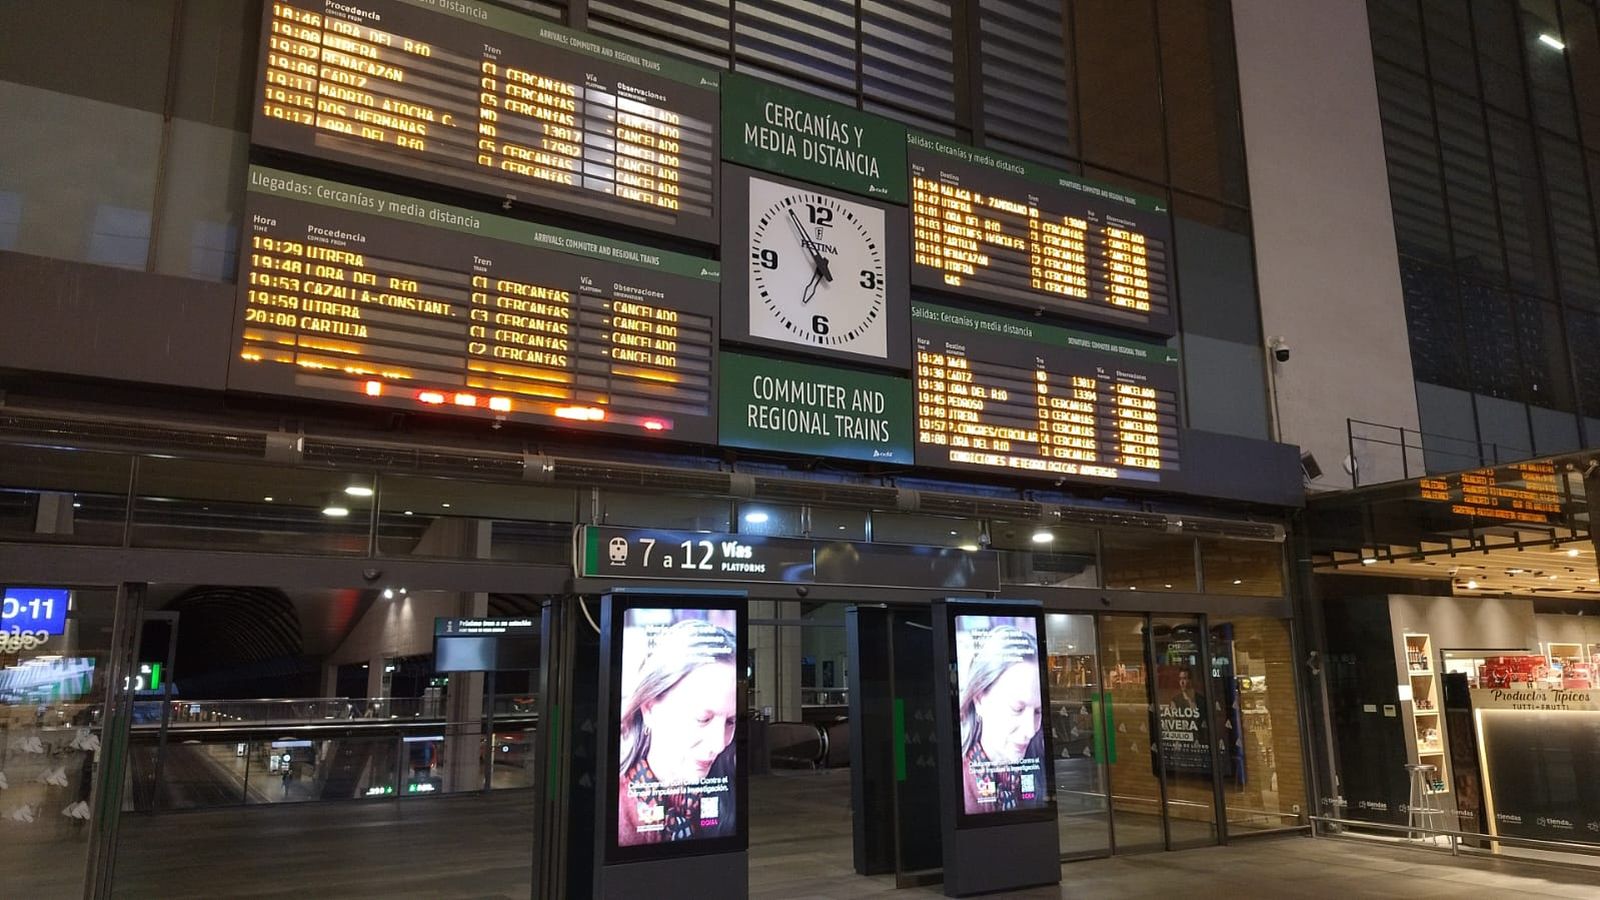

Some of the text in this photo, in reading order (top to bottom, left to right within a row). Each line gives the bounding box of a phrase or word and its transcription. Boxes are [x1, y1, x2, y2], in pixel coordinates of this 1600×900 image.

[273, 5, 320, 26] 18:46
[325, 0, 381, 21] Procedencia
[439, 0, 488, 19] distancia
[324, 18, 360, 37] LORA
[484, 45, 501, 55] Tren
[539, 30, 660, 71] ARRIVALS: COMMUTER AND REGIONAL TRAINS
[269, 54, 317, 76] 19:06
[482, 62, 496, 75] C1
[267, 71, 312, 91] 19:11
[482, 78, 496, 91] C1
[585, 73, 598, 82] Vía
[265, 88, 313, 109] 19:15
[481, 93, 497, 107] C5
[617, 82, 667, 101] Observaciones
[318, 84, 374, 107] MADRID
[382, 100, 434, 122] ATOCHA
[264, 105, 313, 125] 19:17
[318, 101, 426, 136] DOS HERMANAS
[765, 101, 864, 148] CERCANÍAS Y
[479, 139, 496, 152] C5
[617, 128, 679, 153] CANCELADO
[745, 123, 880, 179] MEDIA DISTANCIA
[907, 133, 1025, 175] Salidas: Cercanías y media distancia
[616, 155, 678, 182] CANCELADO
[616, 170, 678, 196] CANCELADO
[252, 172, 480, 230] Llegadas: Cercanías y media distancia
[616, 185, 678, 210] CANCELADO
[253, 214, 277, 226] Hora
[806, 204, 834, 228] 12
[307, 225, 366, 243] Procedencia
[253, 235, 303, 256] 19:29
[534, 231, 660, 266] ARRIVALS: COMMUTER AND REGIONAL TRAINS
[801, 239, 838, 256] FESTINA
[251, 254, 302, 275] 19:48
[307, 246, 364, 268] UTRERA
[473, 256, 492, 267] Tren
[760, 249, 779, 270] 9
[249, 272, 300, 291] 19:53
[305, 263, 344, 282] LORA
[352, 272, 376, 287] DEL
[472, 276, 488, 289] C1
[580, 276, 592, 286] Vía
[860, 270, 876, 290] 3
[247, 290, 299, 310] 19:59
[472, 292, 487, 306] C1
[613, 283, 665, 299] Observaciones
[245, 308, 297, 327] 20:00
[302, 298, 360, 319] UTRERA
[470, 308, 488, 322] C3
[613, 301, 678, 322] CANCELADO
[300, 316, 368, 338] CARTUJA
[470, 325, 485, 338] C1
[612, 316, 677, 337] CANCELADO
[812, 315, 829, 335] 6
[912, 306, 1032, 337] Salidas: Cercanías y media distancia
[468, 342, 486, 354] C2
[612, 332, 677, 352] CANCELADO
[611, 348, 676, 368] CANCELADO
[753, 374, 885, 414] COMMUTER AND
[748, 404, 889, 443] REGIONAL TRAINS
[639, 538, 753, 570] 7 a 12 Vías
[721, 562, 766, 573] PLATFORMS
[1491, 689, 1547, 701] Productos
